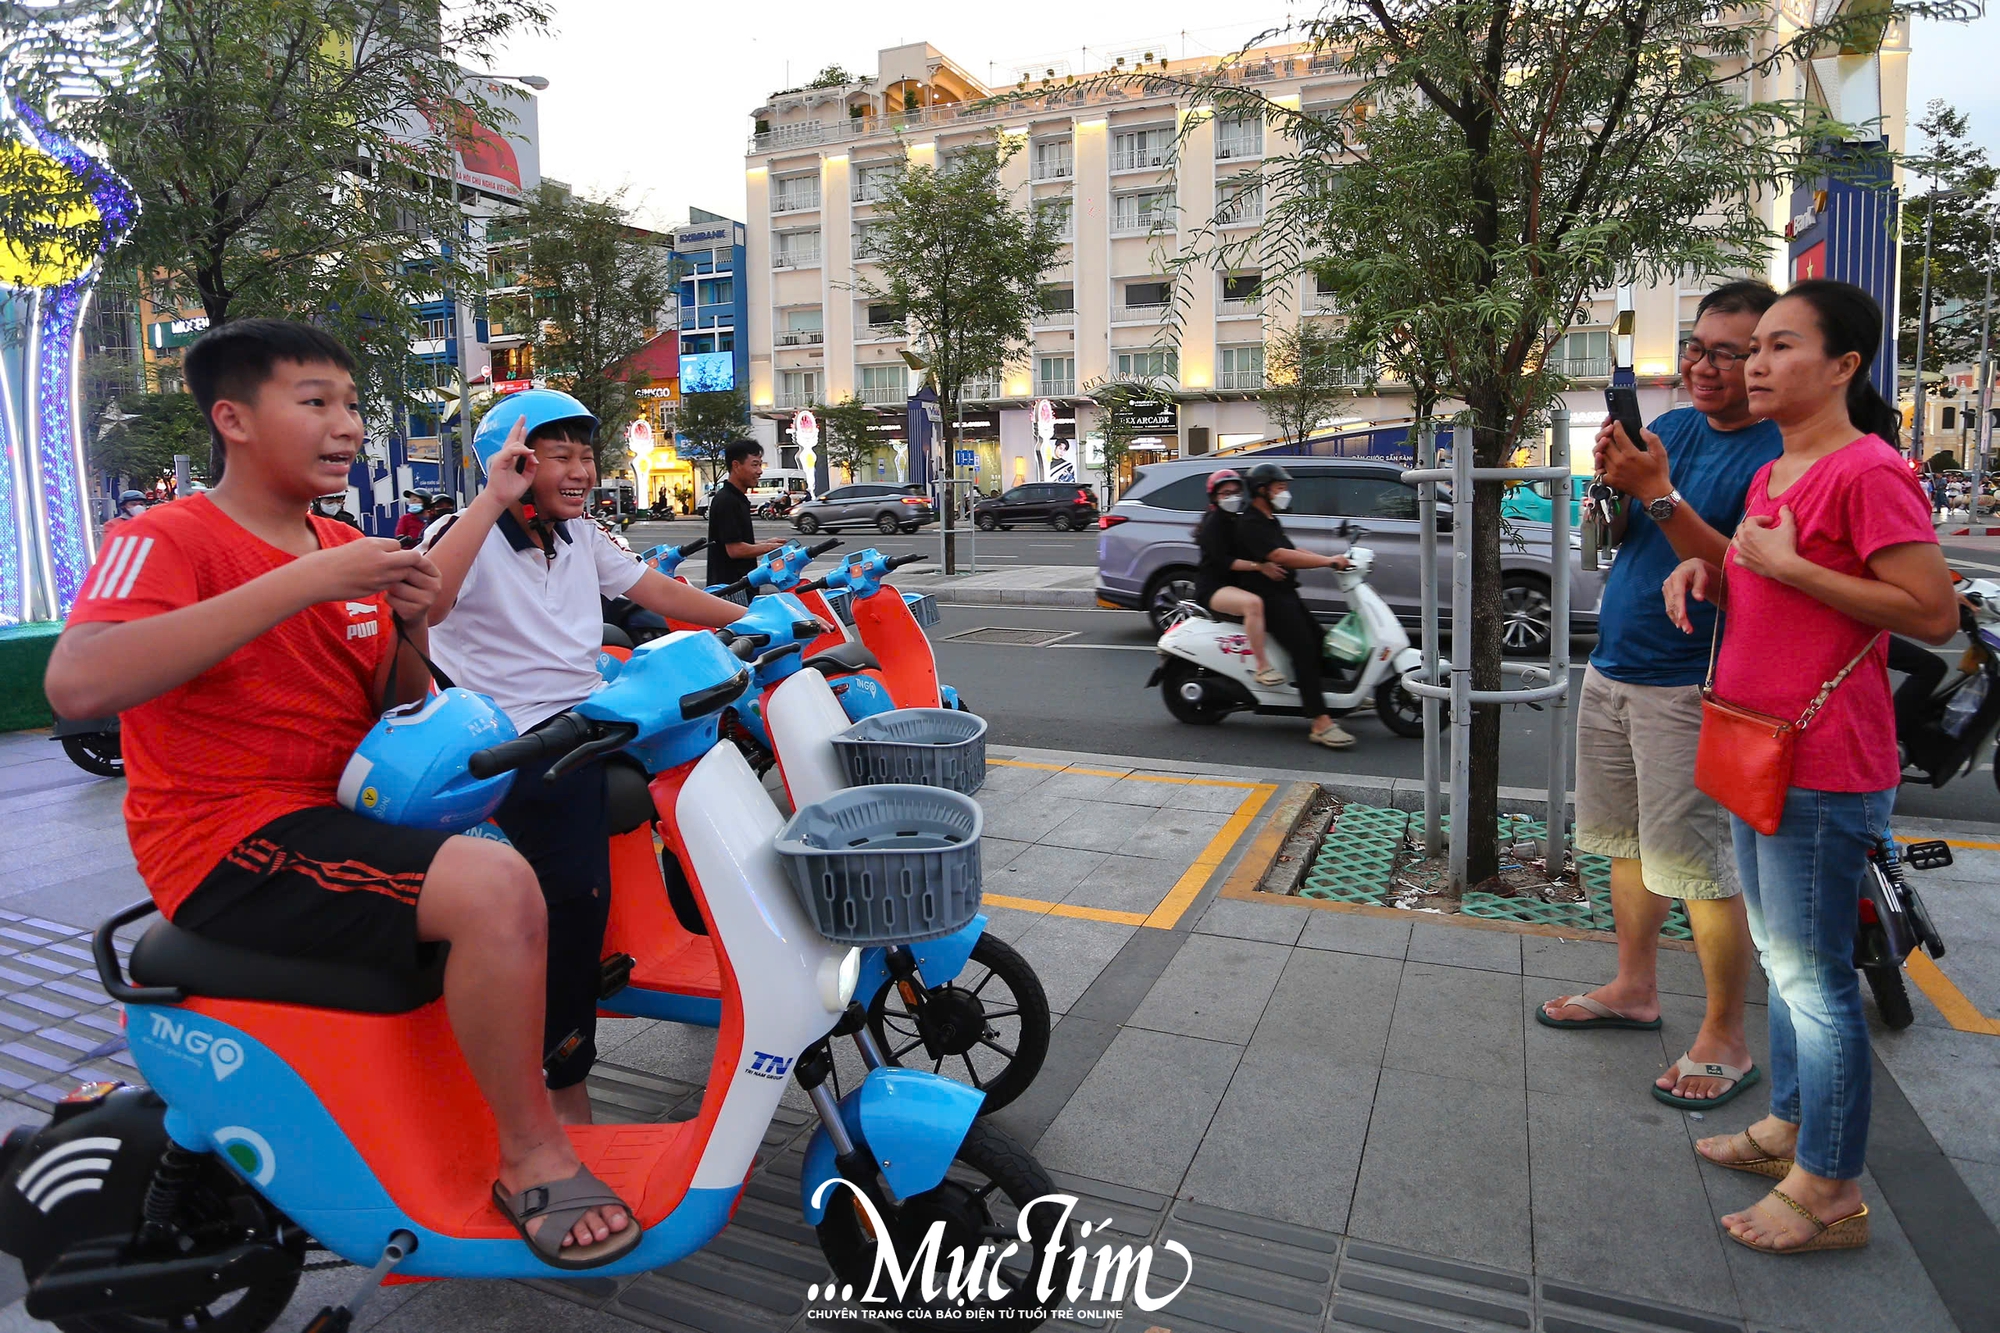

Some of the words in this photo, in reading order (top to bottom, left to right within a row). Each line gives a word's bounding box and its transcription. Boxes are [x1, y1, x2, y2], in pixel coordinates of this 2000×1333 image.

[680, 229, 726, 243] EXIMBANK
[1082, 374, 1106, 391] REX
[634, 387, 671, 398] GINKGO
[1136, 416, 1170, 425] ARCADE
[347, 620, 378, 640] PUM
[751, 1050, 794, 1075] TN
